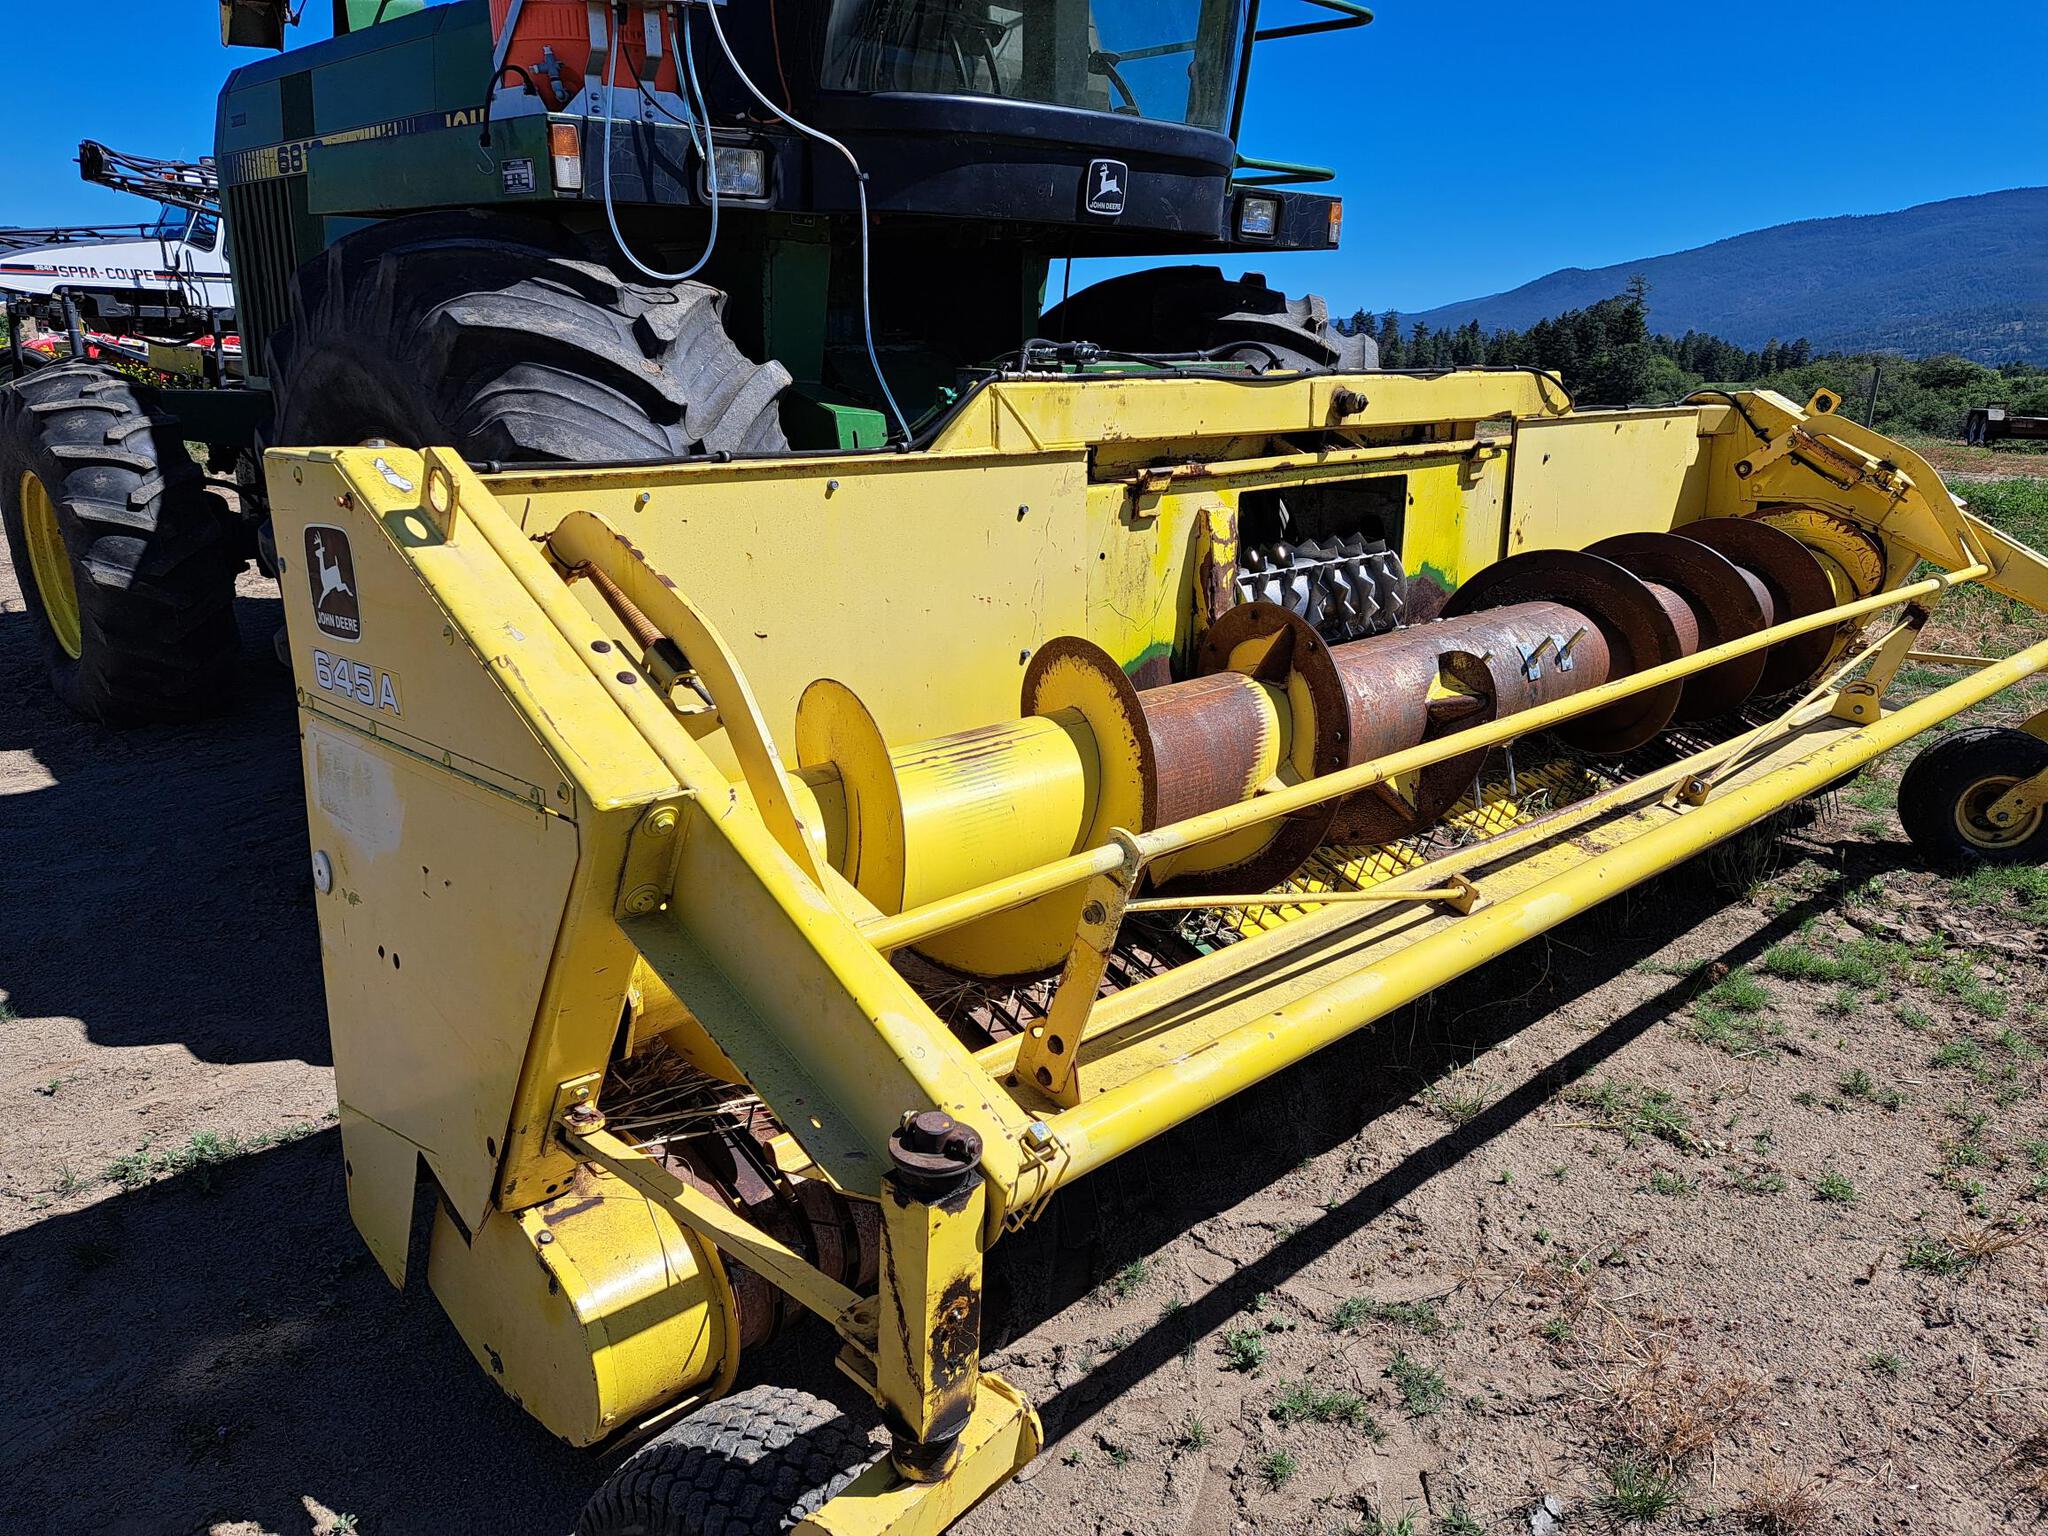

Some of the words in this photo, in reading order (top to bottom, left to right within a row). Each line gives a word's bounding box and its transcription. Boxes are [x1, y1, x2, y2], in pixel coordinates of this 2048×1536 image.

[278, 140, 323, 174] 68
[1090, 201, 1105, 209] JOHN
[1106, 202, 1121, 210] DEERE
[60, 265, 154, 281] SPRA-COUPE
[318, 611, 335, 628] JOHN
[335, 615, 359, 632] DEERE
[314, 649, 401, 715] 645A
